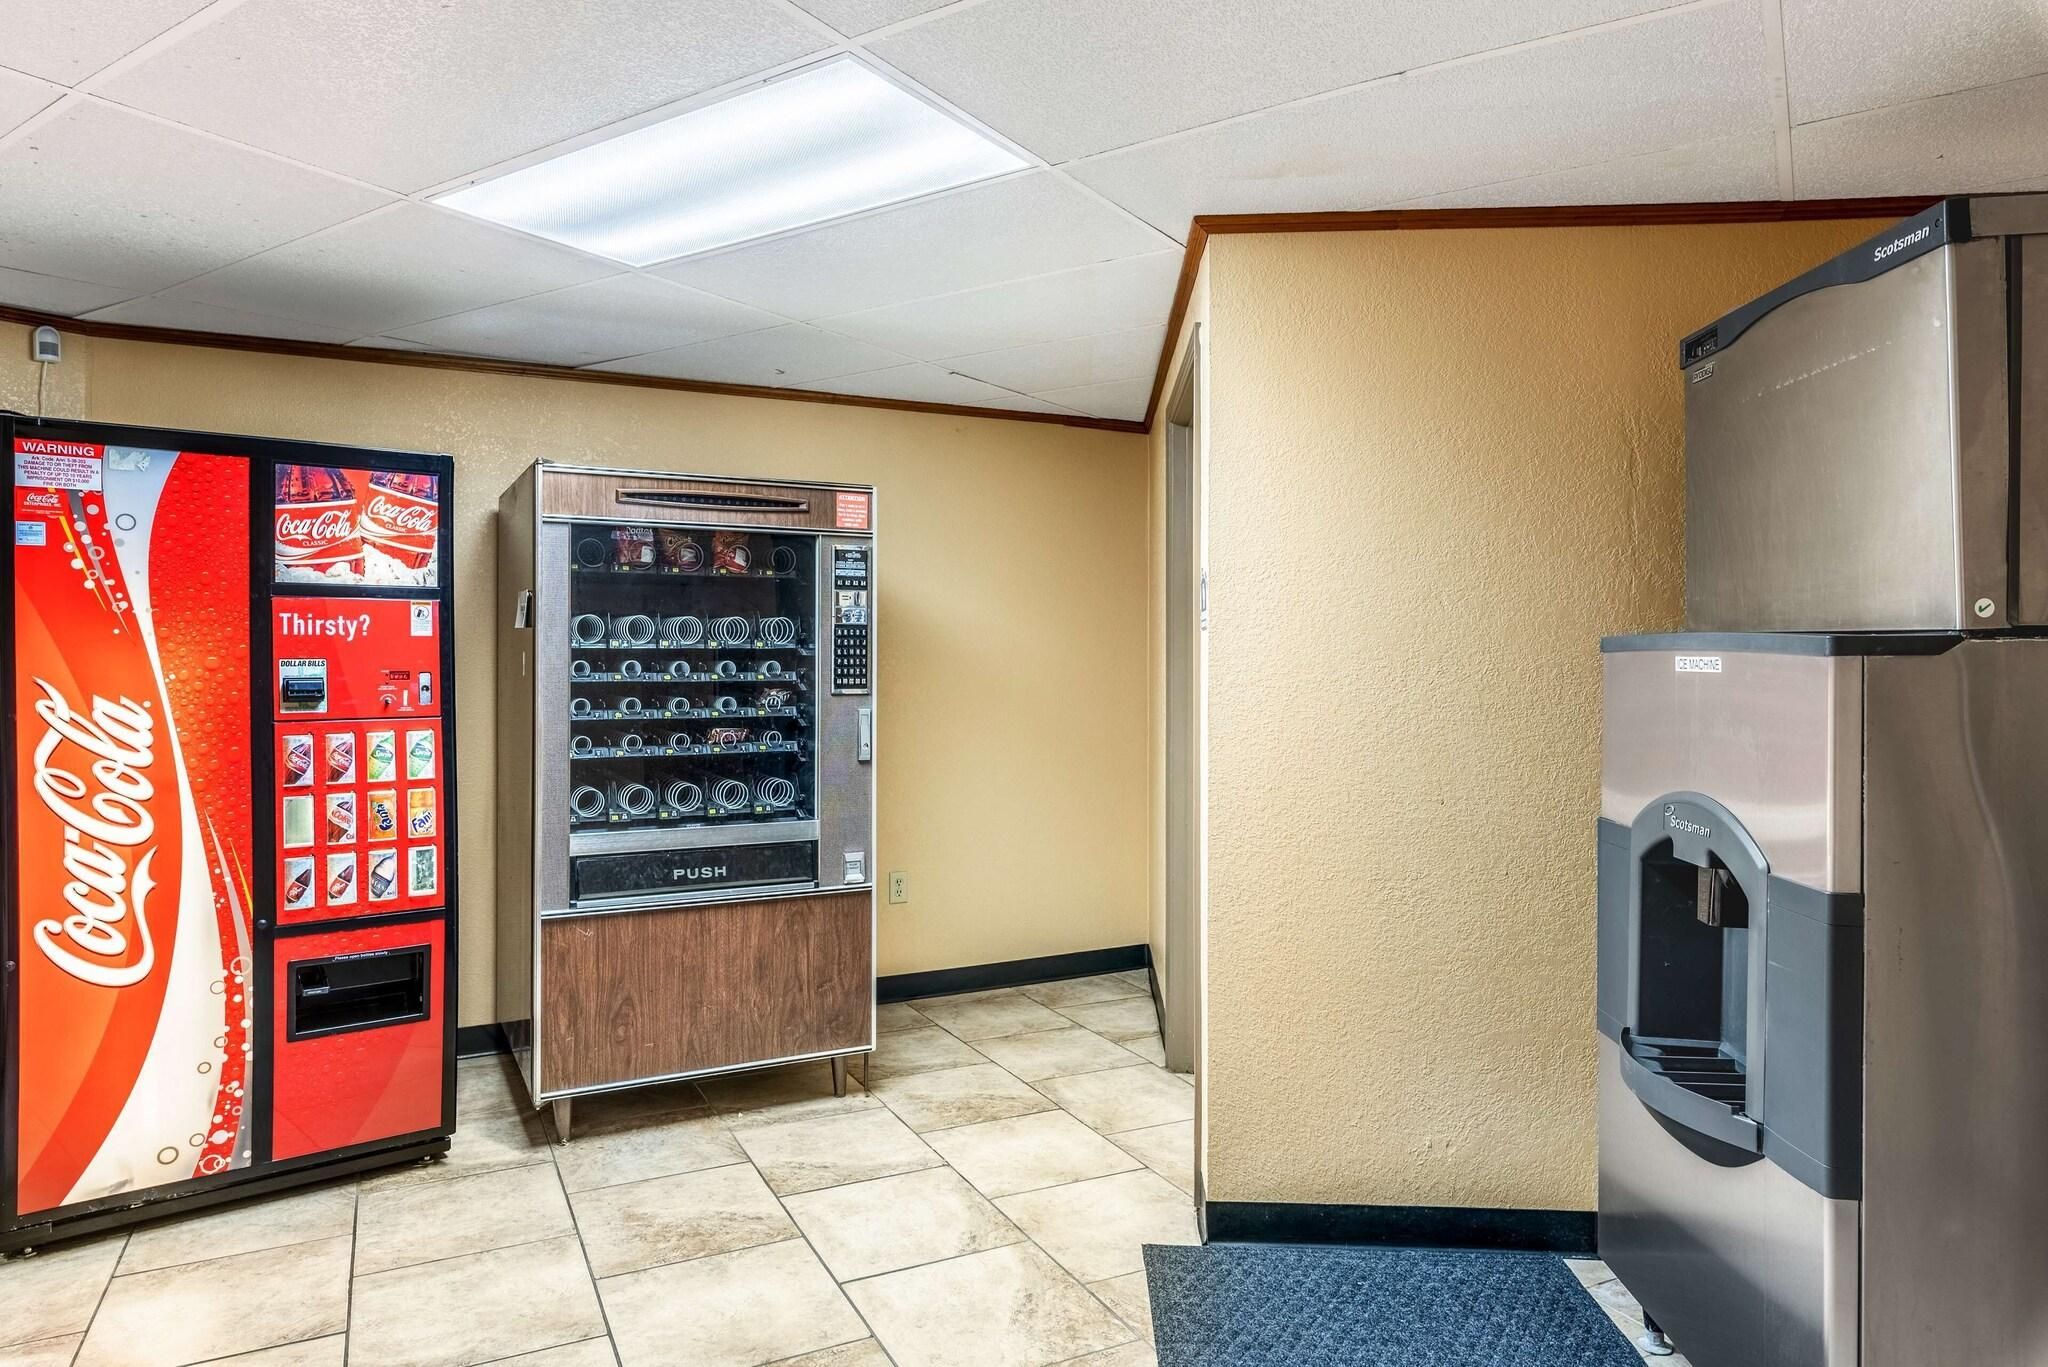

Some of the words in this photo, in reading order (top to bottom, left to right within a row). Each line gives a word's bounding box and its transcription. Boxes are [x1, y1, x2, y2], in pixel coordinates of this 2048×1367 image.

[1874, 225, 1930, 262] Scotsman
[22, 441, 94, 457] WARNING
[368, 496, 438, 531] Coca-Cola
[276, 510, 352, 541] Coca-Cola
[385, 523, 407, 532] CLASSIC
[279, 613, 370, 641] Thirsty?
[281, 660, 307, 668] DOLLAR
[1677, 659, 1687, 669] ICE
[1689, 659, 1720, 670] MACHINE
[32, 675, 158, 988] Coca-Cola
[1670, 815, 1710, 838] Scotsman
[673, 866, 727, 880] PUSH
